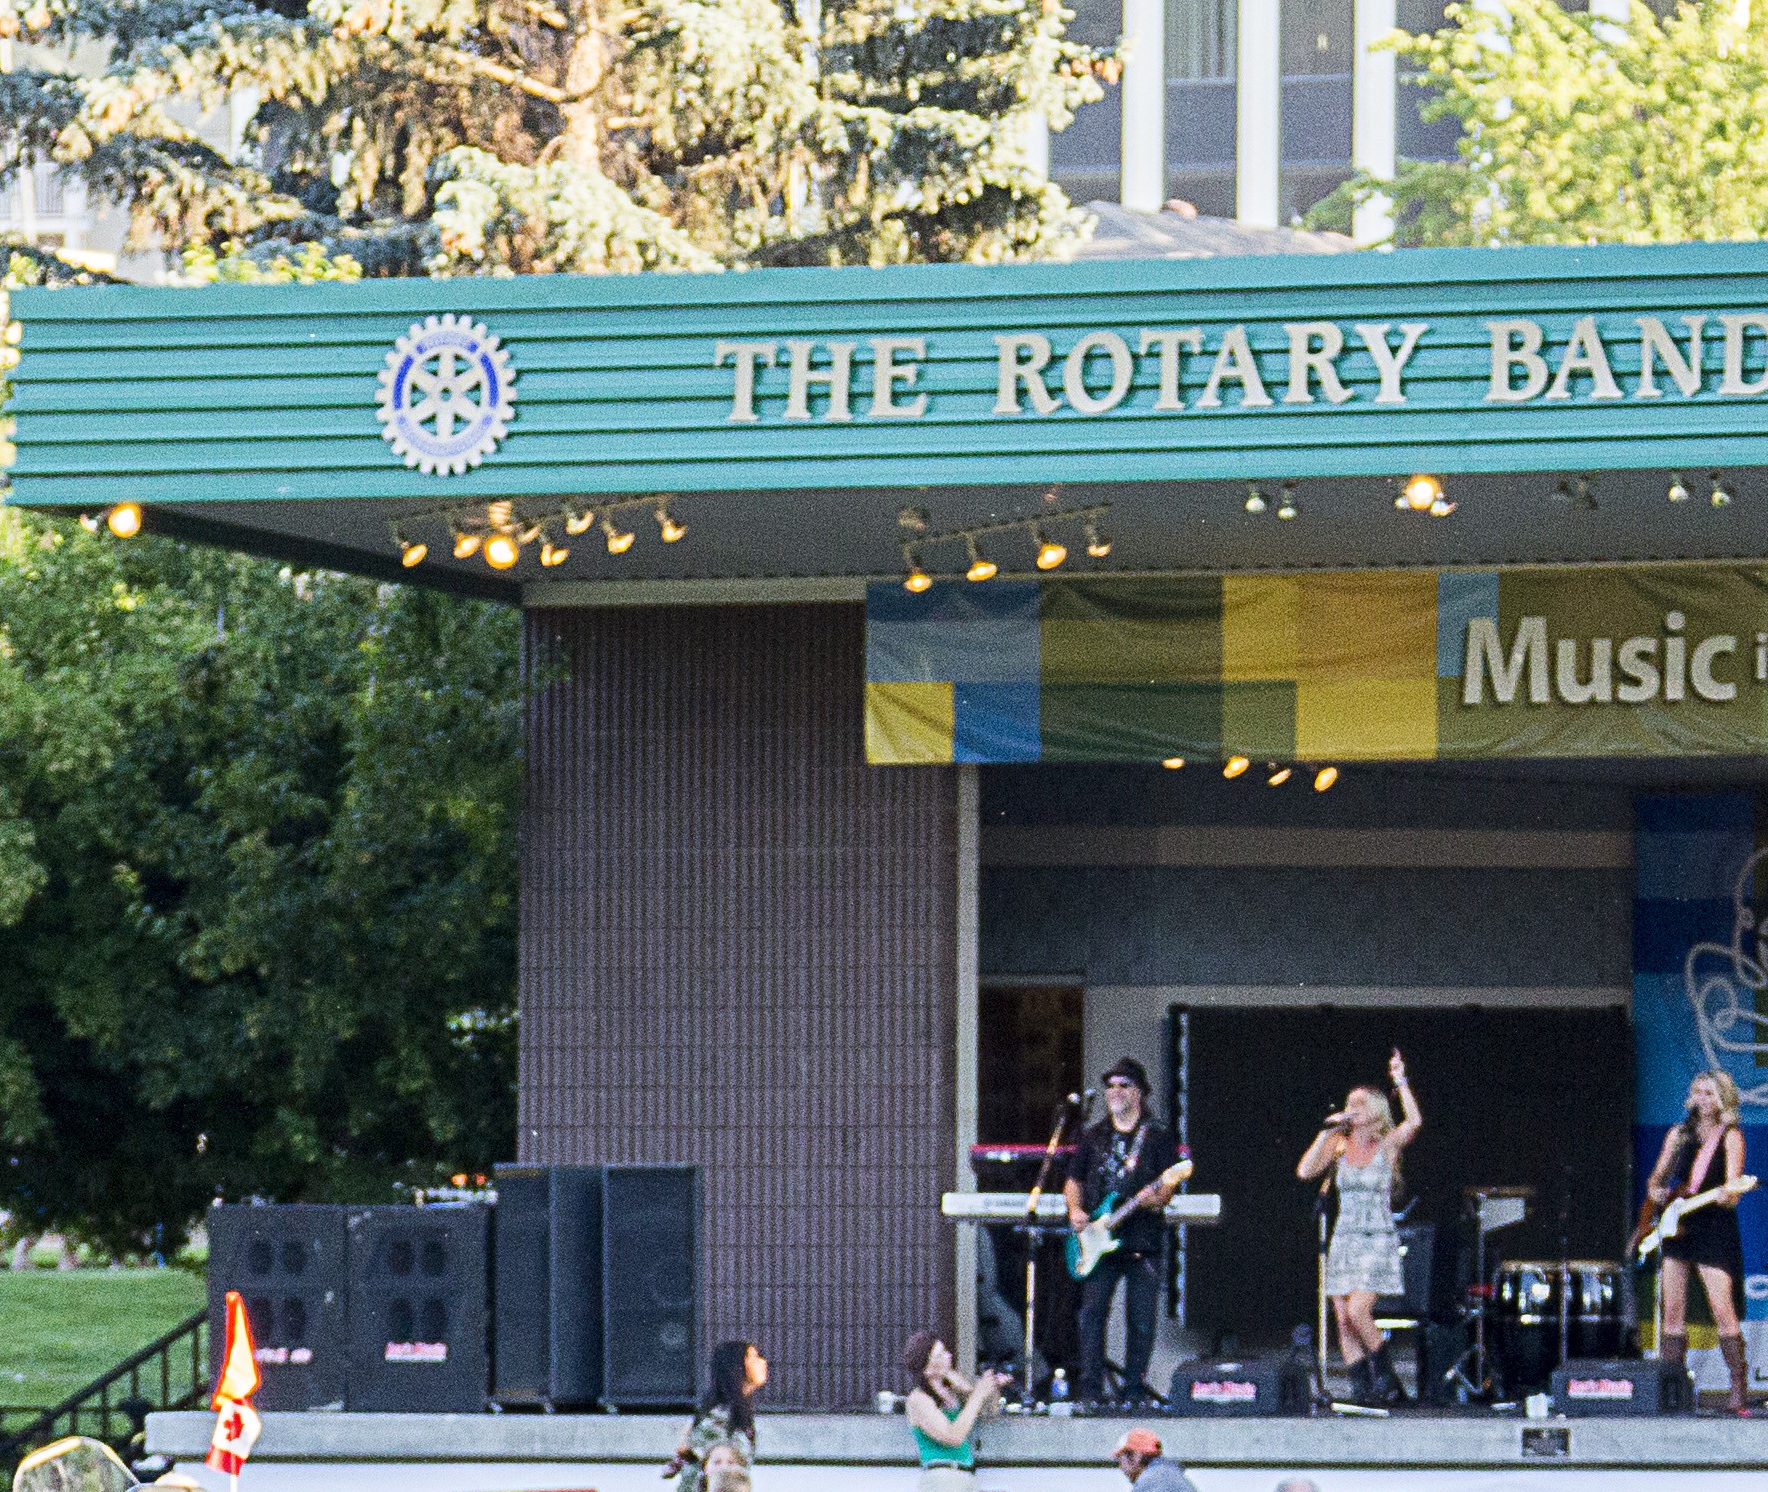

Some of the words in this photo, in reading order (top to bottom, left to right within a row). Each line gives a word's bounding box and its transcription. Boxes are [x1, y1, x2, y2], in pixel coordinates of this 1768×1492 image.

[714, 335, 928, 422] THE
[992, 321, 1429, 416] ROTARY
[1463, 611, 1738, 704] Music
